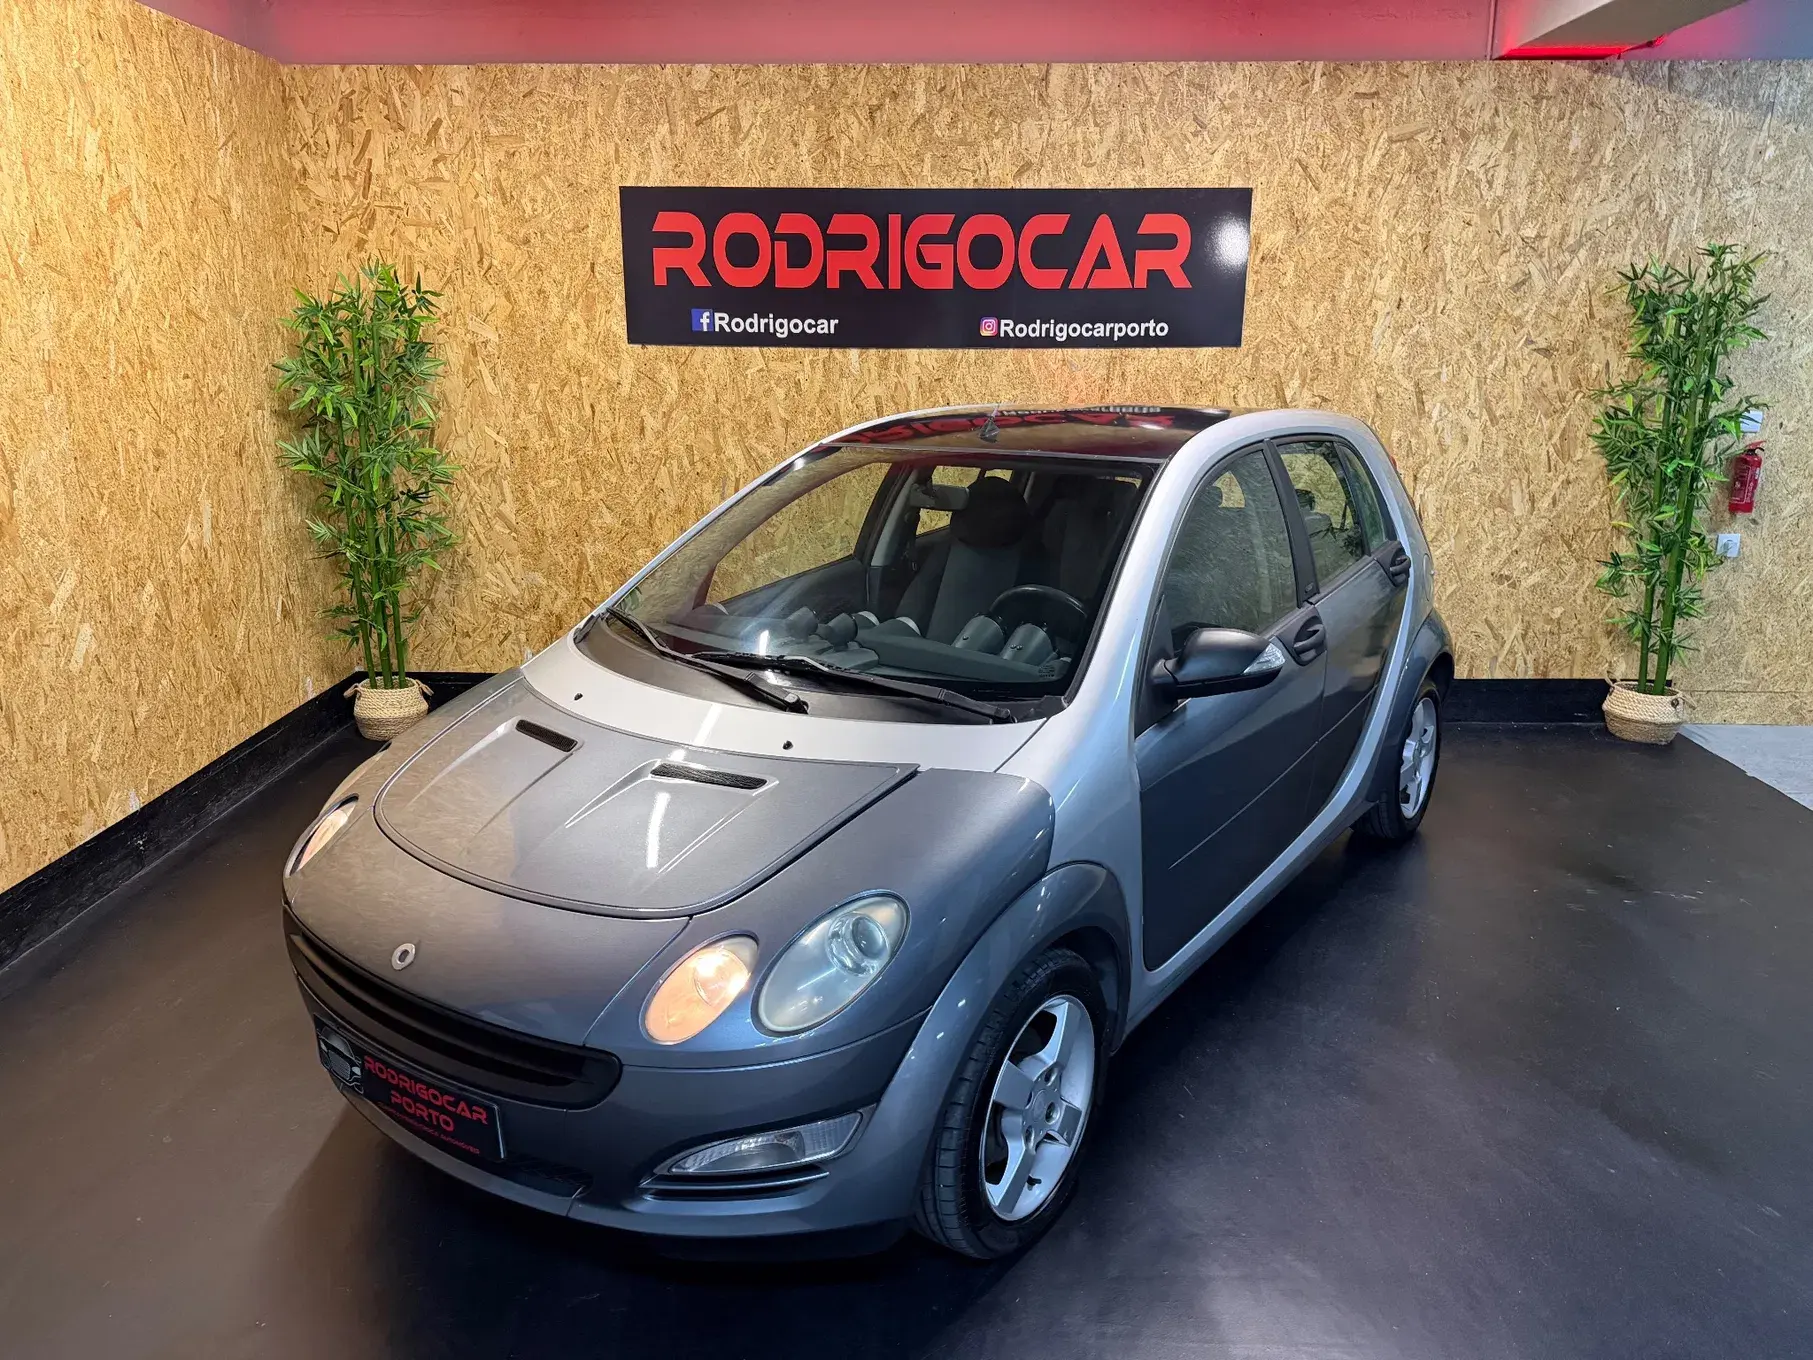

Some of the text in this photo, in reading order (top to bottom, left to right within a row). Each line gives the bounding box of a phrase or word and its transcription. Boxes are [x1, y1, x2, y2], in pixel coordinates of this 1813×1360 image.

[651, 211, 1193, 290] RODRIGOCAR
[714, 312, 839, 339] Rodrigocar
[1000, 318, 1170, 342] Rodrigocarporto
[364, 1055, 489, 1125] RODRIGOCAR
[391, 1089, 455, 1132] PORTO
